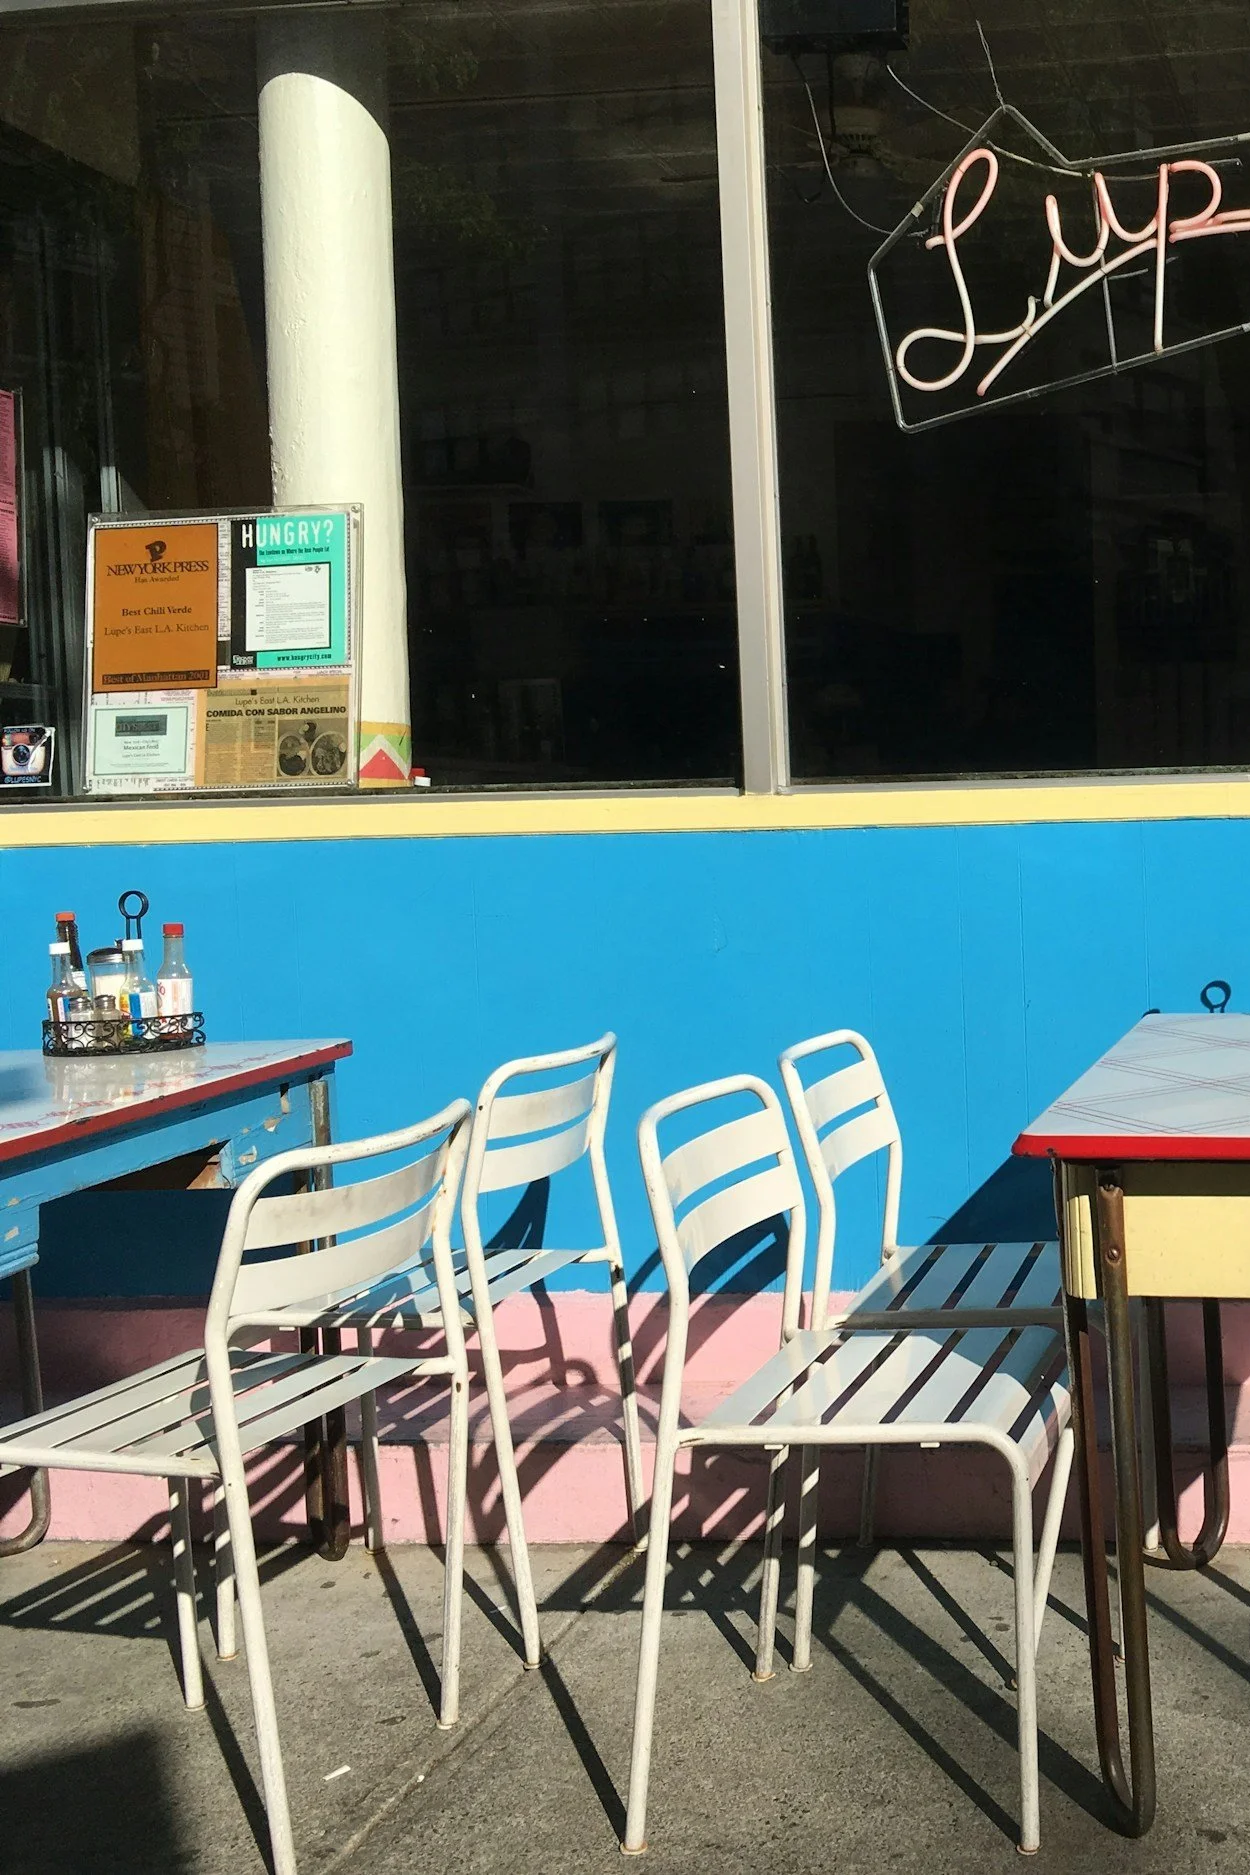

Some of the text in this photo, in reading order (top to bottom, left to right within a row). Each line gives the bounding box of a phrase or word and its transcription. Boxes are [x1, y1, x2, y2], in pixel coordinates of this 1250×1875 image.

[241, 519, 334, 548] HUNGRY?
[106, 560, 210, 576] NEW YORK PRESS
[134, 575, 180, 584] Has Awarded
[122, 606, 192, 617] Best Chili Verde
[104, 623, 210, 638] Lupe's East L.A. Kitchen
[103, 675, 124, 684] Best
[125, 675, 136, 683] of
[136, 672, 187, 683] Manhattan
[235, 694, 320, 708] Lupe's East L.A. Kitchen
[206, 706, 347, 718] COMIDA CON SABOR ANGELINO
